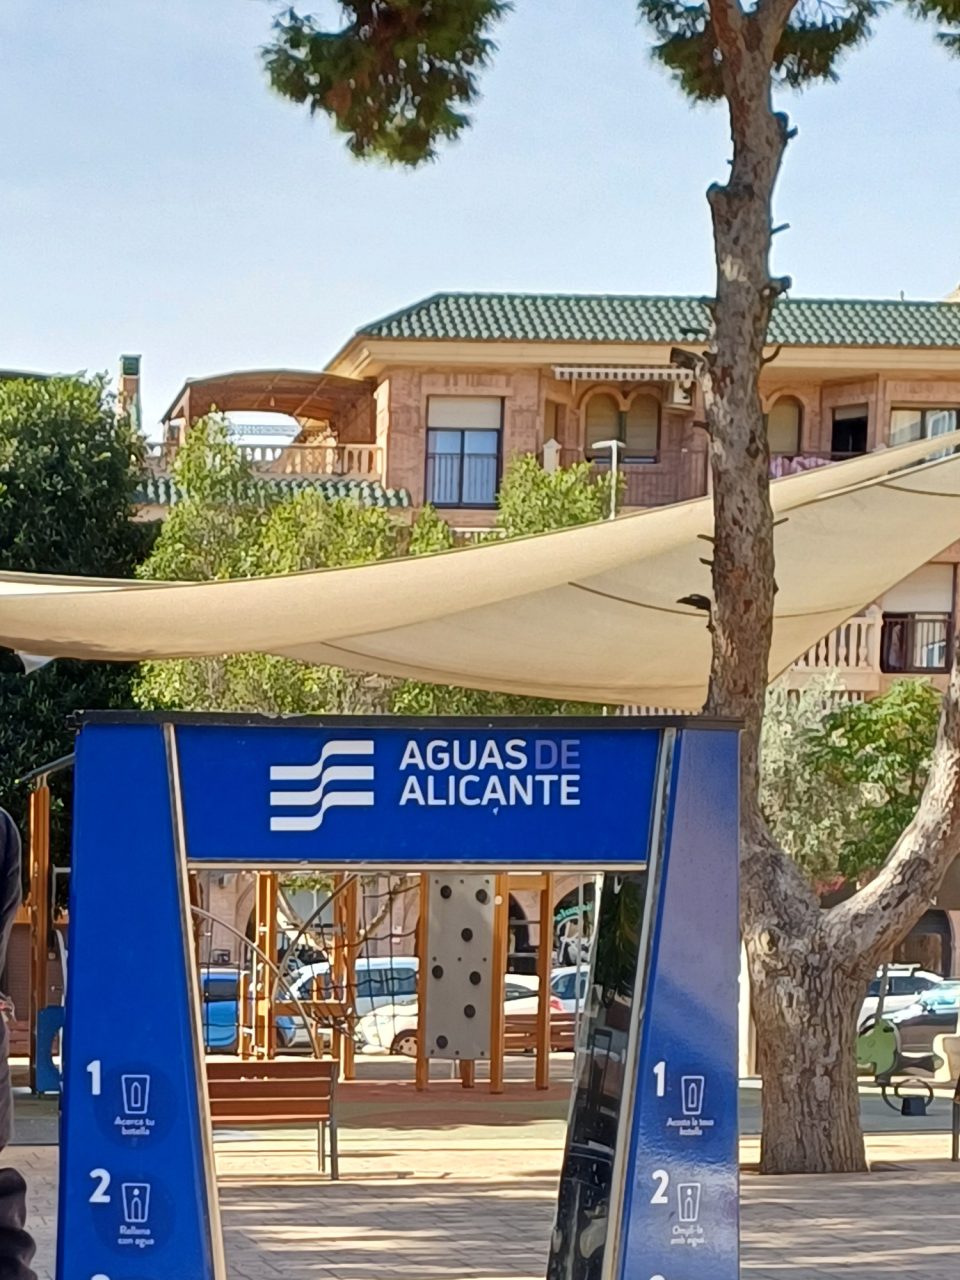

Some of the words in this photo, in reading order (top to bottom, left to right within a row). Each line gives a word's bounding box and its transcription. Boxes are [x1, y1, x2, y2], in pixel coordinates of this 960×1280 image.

[399, 739, 528, 770] AGUAS
[534, 739, 581, 770] DE
[399, 774, 581, 806] ALICANTE
[86, 1060, 101, 1095] 1
[653, 1061, 666, 1097] 1
[121, 1126, 150, 1136] botella
[145, 1117, 155, 1126] tu
[89, 1168, 111, 1203] 2
[650, 1169, 670, 1204] 2
[119, 1225, 151, 1235] Rellena
[135, 1238, 155, 1248] agua
